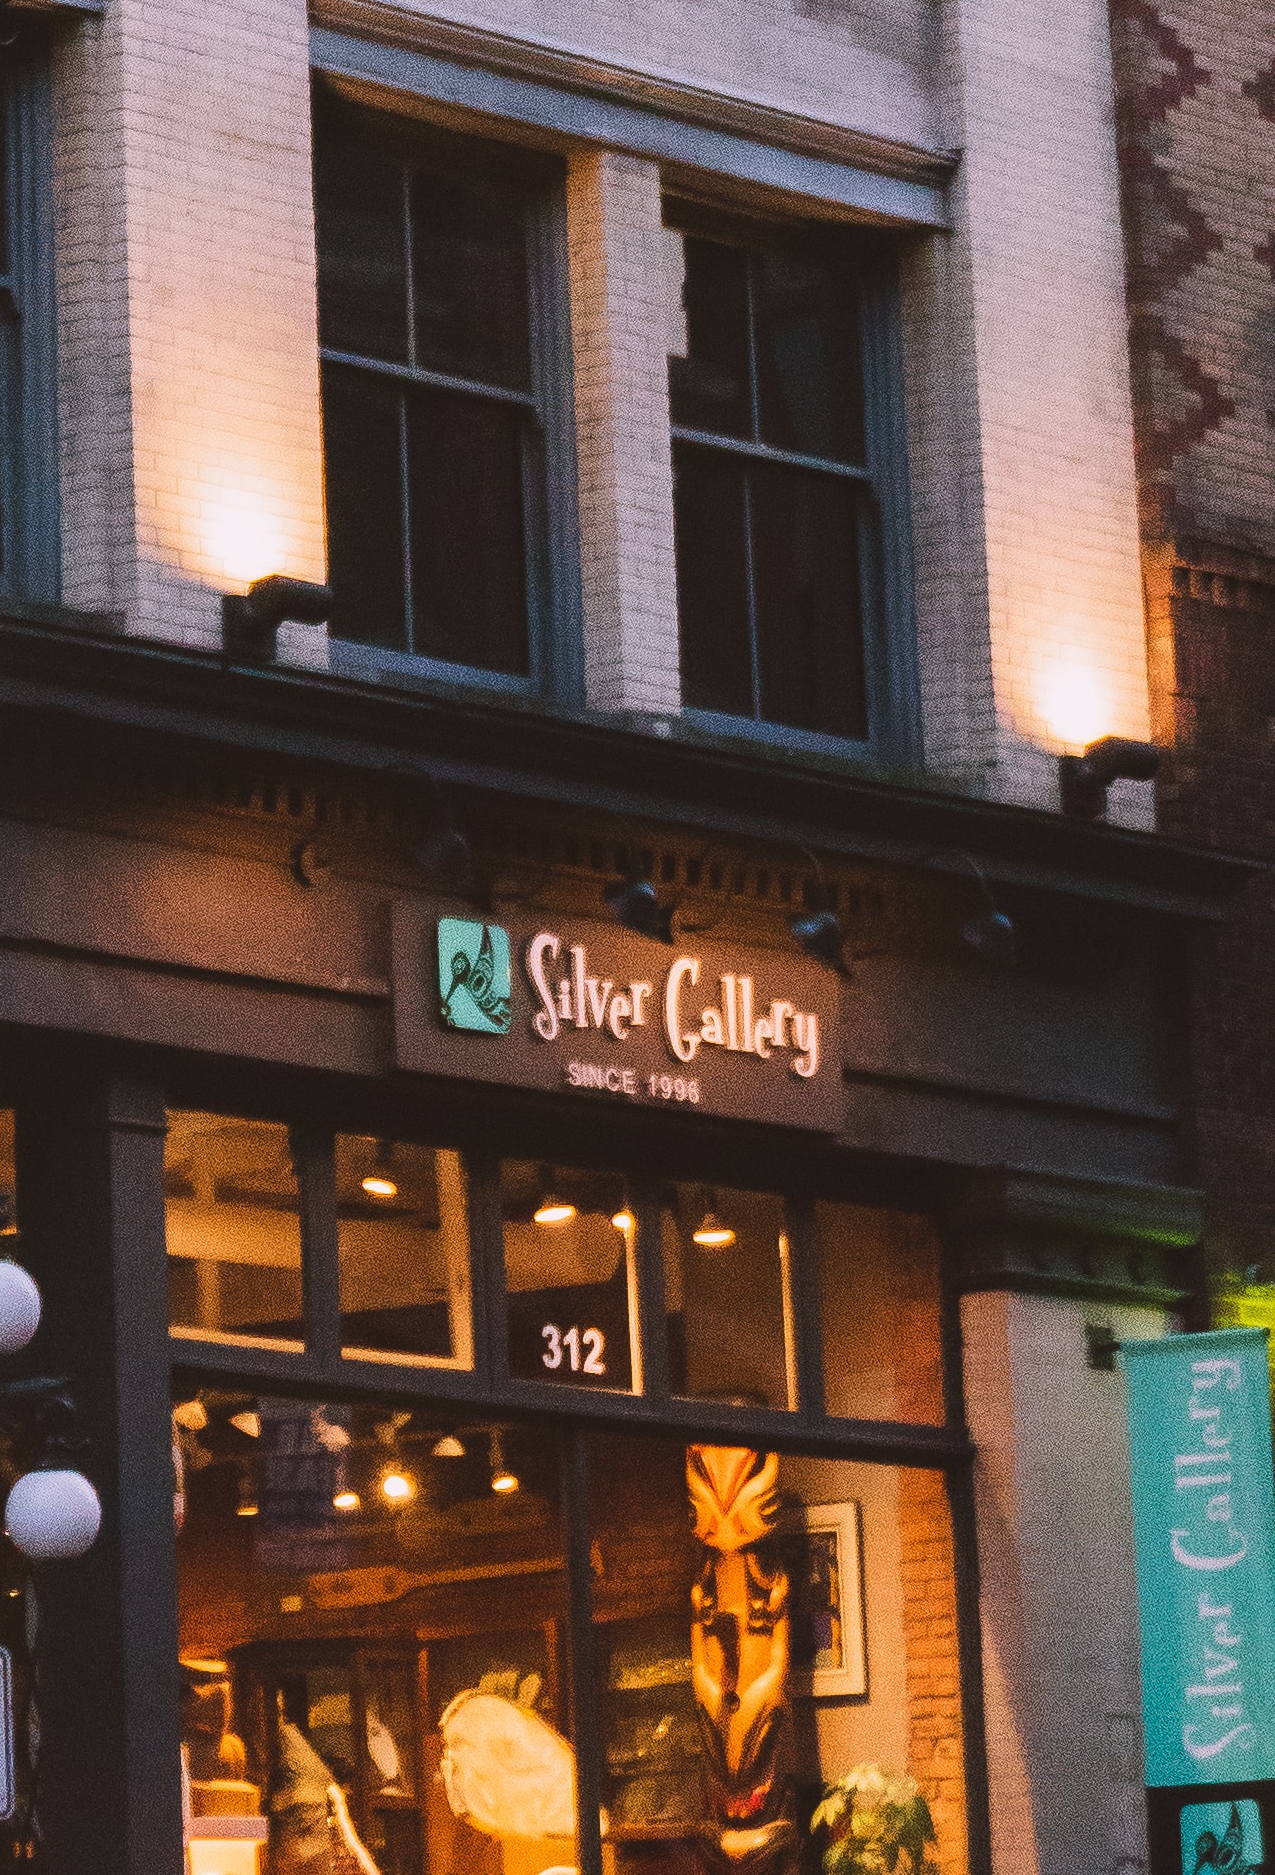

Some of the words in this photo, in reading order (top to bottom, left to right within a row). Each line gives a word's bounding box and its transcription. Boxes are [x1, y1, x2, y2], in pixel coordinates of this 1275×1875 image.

[528, 933, 649, 1041] Silver
[666, 956, 820, 1079] Gallery
[566, 1061, 637, 1096] SINCE
[649, 1074, 701, 1105] 1996
[541, 1323, 607, 1376] 312
[1170, 1357, 1248, 1573] Gallery
[1181, 1593, 1254, 1760] Silver
